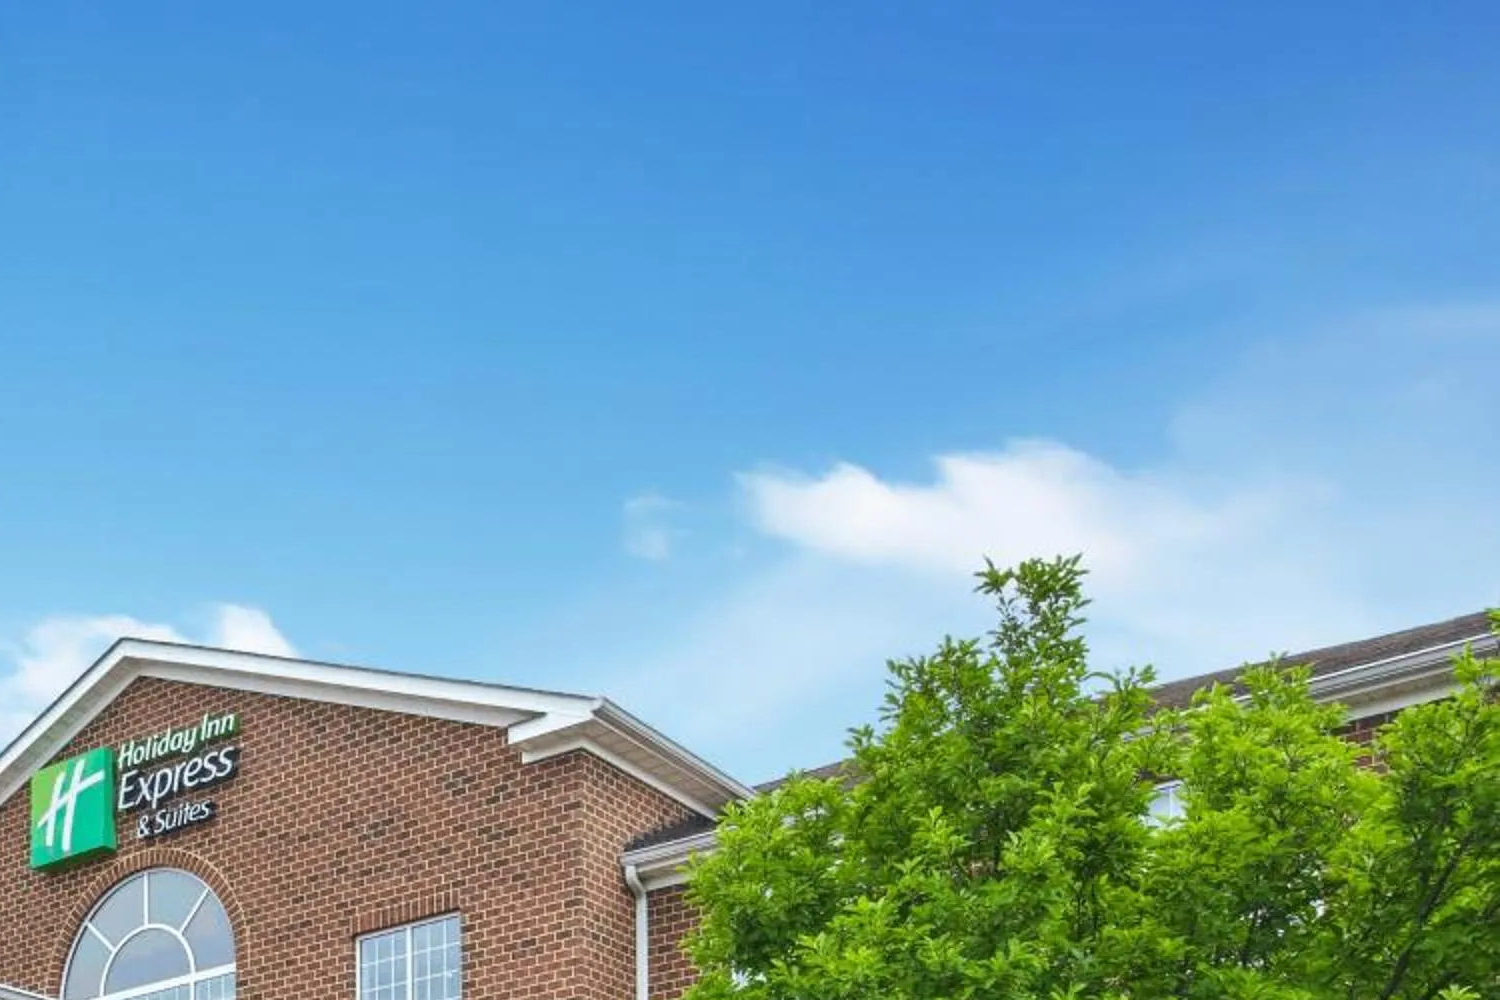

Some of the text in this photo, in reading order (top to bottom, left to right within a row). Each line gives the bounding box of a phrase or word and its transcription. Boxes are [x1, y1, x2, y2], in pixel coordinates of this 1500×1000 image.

[118, 713, 235, 769] Holiday Inn
[117, 746, 236, 811] Express
[137, 799, 211, 839] & Suites
